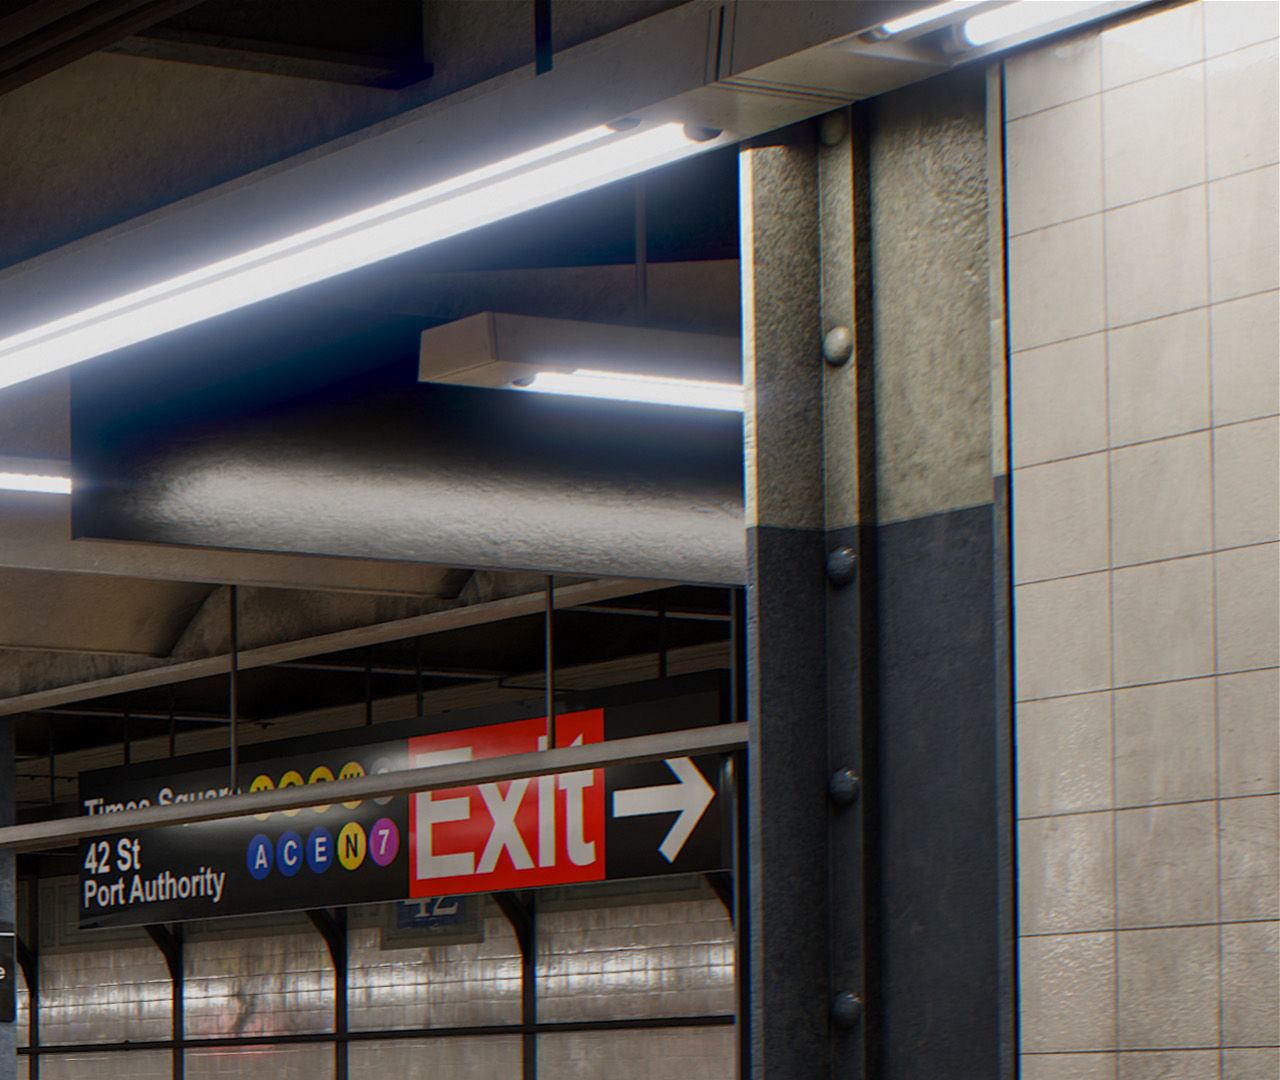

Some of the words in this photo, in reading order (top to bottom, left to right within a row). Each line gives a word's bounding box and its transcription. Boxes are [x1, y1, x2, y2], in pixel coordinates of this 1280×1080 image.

[415, 733, 597, 881] Exit
[83, 841, 112, 875] 42
[116, 837, 142, 872] St
[83, 876, 126, 909] Port
[127, 866, 227, 904] Authority
